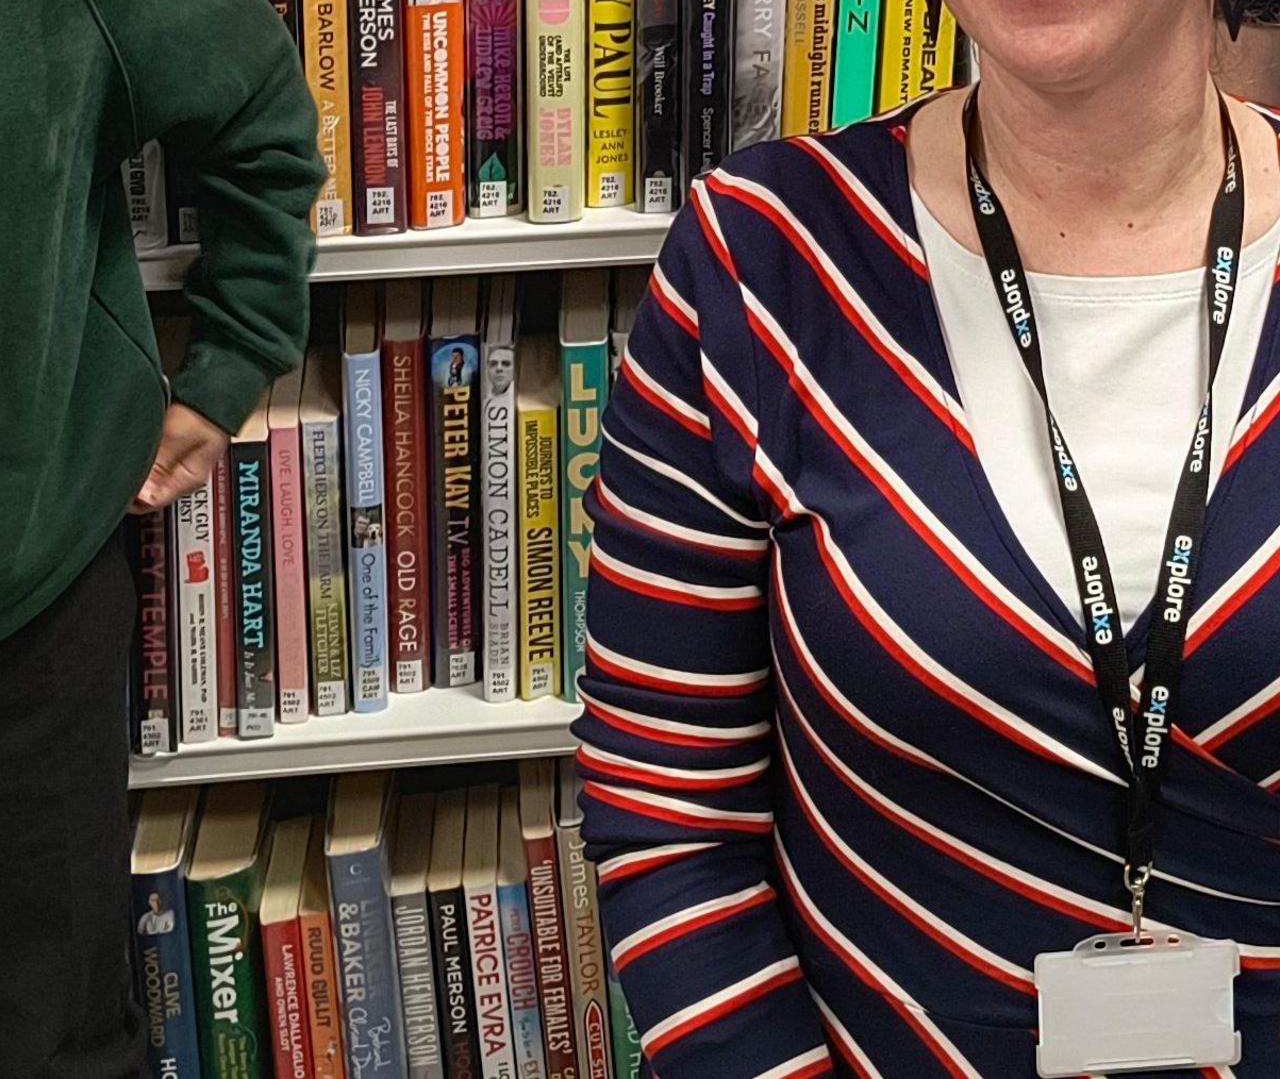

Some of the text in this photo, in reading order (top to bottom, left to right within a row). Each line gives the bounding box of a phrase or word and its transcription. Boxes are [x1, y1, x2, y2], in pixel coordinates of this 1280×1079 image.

[316, 3, 335, 91] BARLOW
[431, 11, 451, 184] UNCOMMON PEOPLE
[592, 25, 632, 118] PAUL
[998, 268, 1033, 349] explore
[1211, 245, 1235, 326] explore
[355, 369, 376, 505] NICKY CAMPBELL
[443, 385, 472, 509] PETER KAY
[238, 461, 261, 577] MIRANDA
[393, 356, 417, 652] SHEILA HANCOCK OLD RAGE
[486, 405, 510, 618] SIMON CADELL
[240, 581, 265, 649] HART
[526, 527, 555, 662] SIMON REEVE
[1075, 554, 1116, 646] explore
[1162, 533, 1194, 625] explore
[1140, 684, 1171, 770] explore
[205, 901, 237, 916] The
[205, 915, 240, 1024] Mixer
[439, 904, 467, 1034] PAUL MERSON
[469, 893, 507, 1057] PATRICE EVRA
